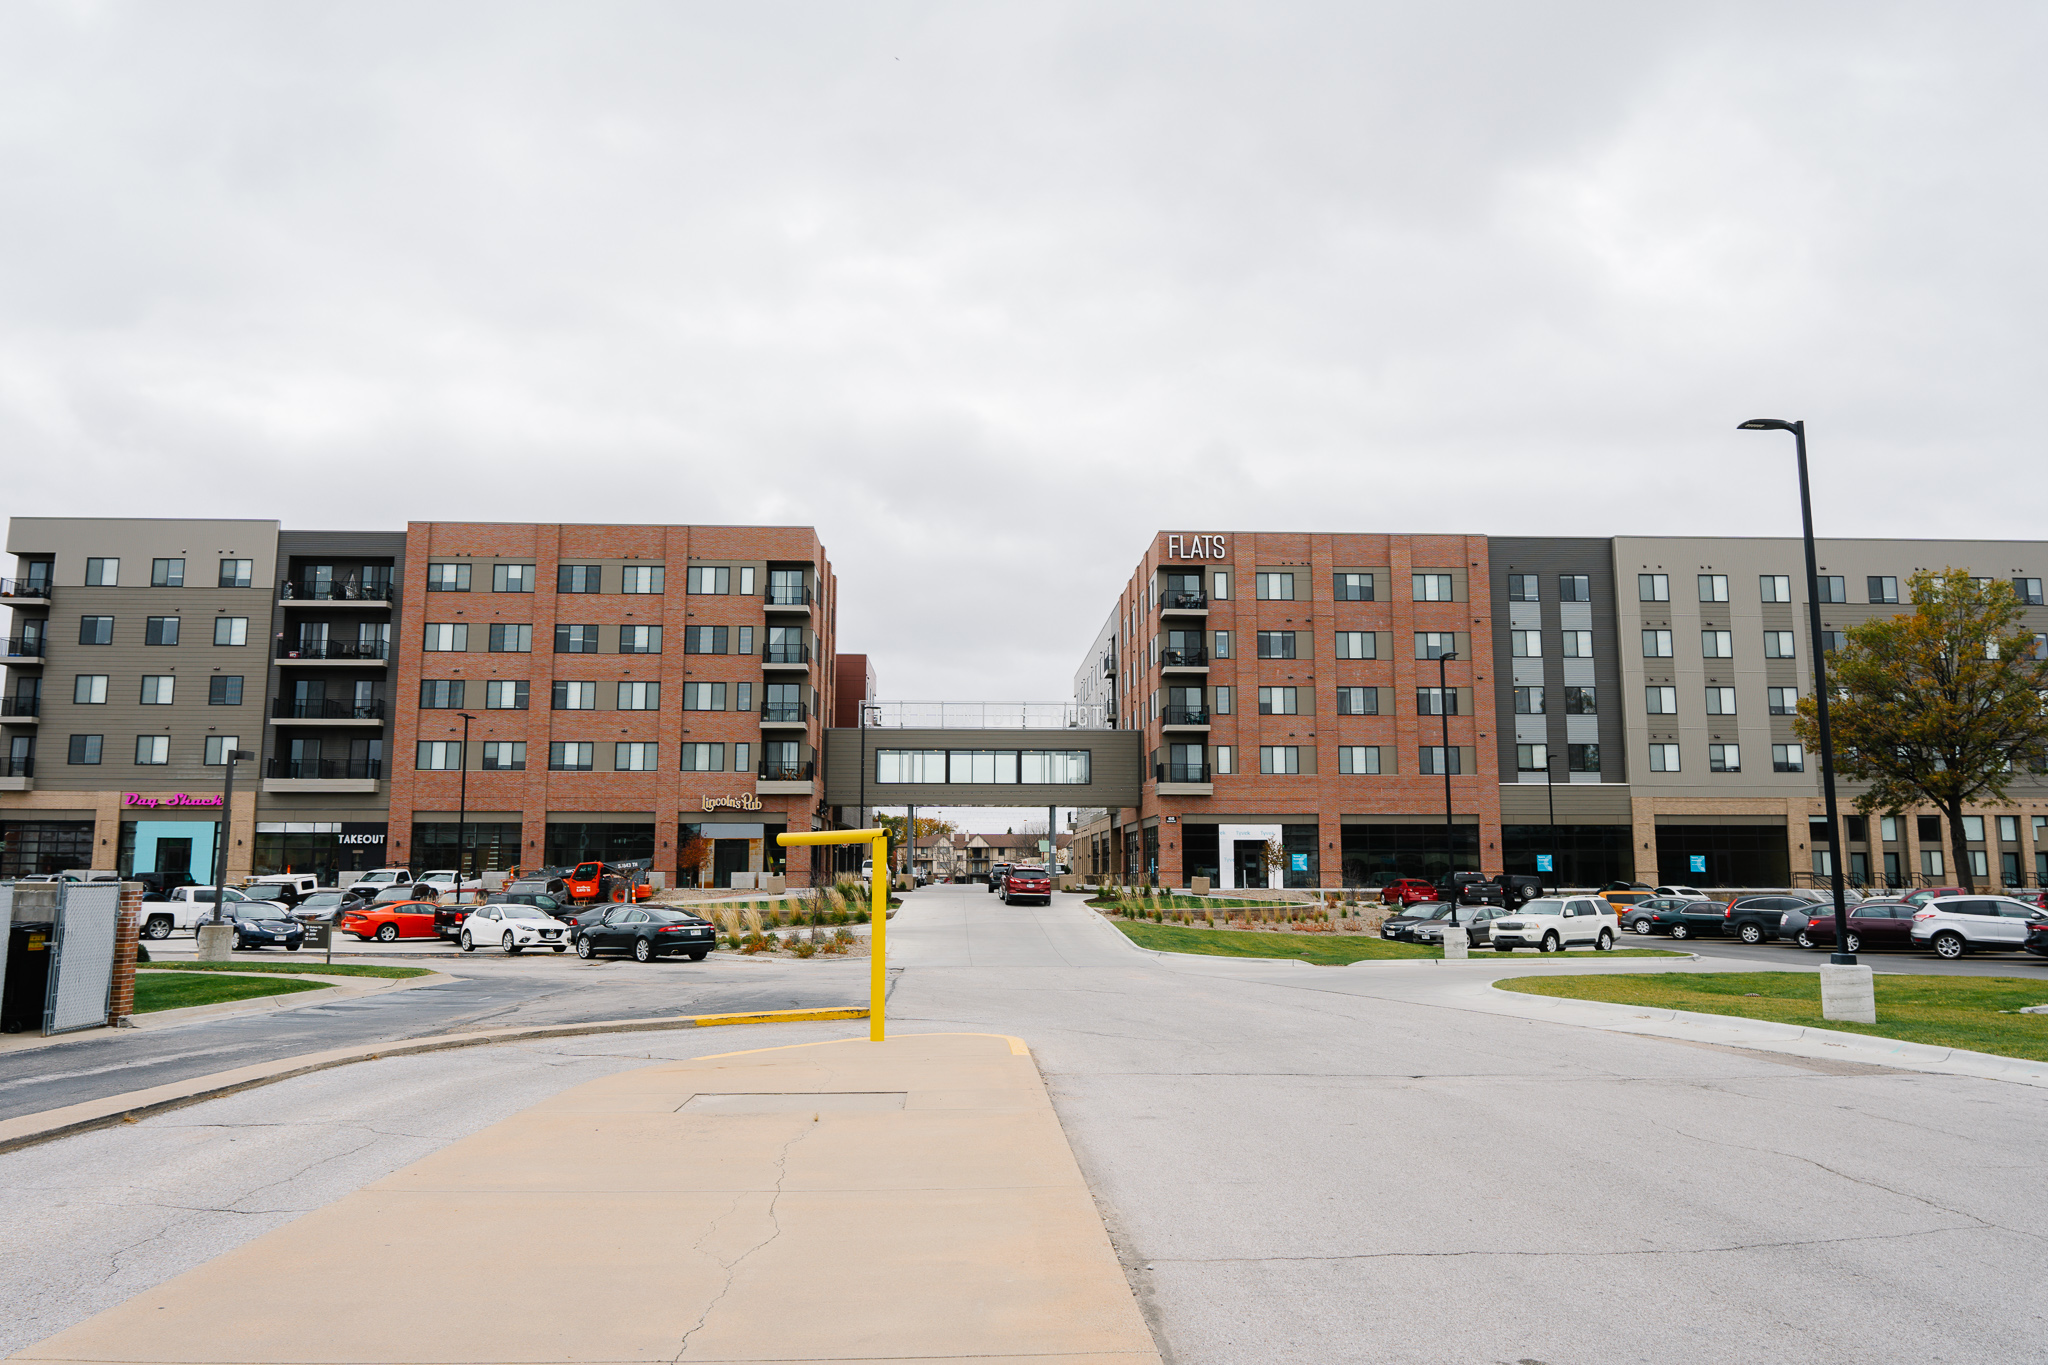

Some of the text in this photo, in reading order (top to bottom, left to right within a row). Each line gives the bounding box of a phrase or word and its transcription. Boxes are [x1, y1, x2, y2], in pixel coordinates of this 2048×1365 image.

[1168, 534, 1225, 559] FLATS
[165, 793, 223, 806] Shack
[701, 792, 762, 812] Lincoln's Pub
[338, 834, 385, 844] TAKEOUT
